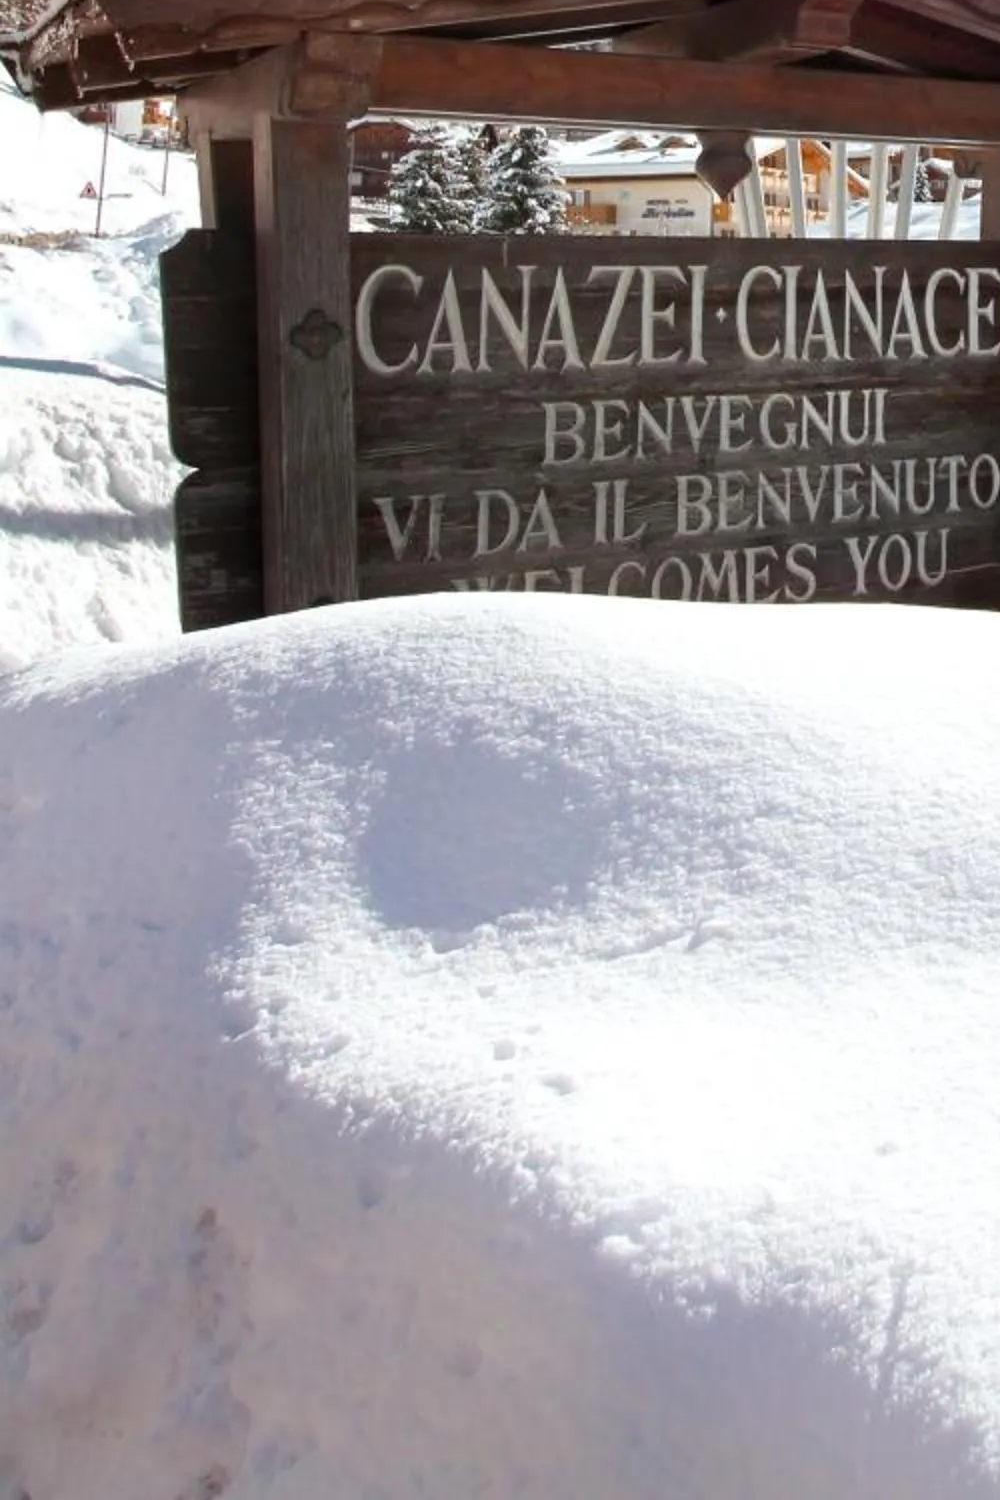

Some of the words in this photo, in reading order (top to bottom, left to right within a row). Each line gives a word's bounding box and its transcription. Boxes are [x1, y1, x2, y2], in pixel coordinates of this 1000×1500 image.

[355, 263, 708, 376] CANAZEI
[542, 388, 888, 467] BENVEGNUI
[374, 493, 445, 563] VI
[592, 479, 647, 546] IL
[674, 453, 1000, 537] BENVENUTO
[450, 543, 817, 603] COMES
[844, 528, 950, 595] YOU
